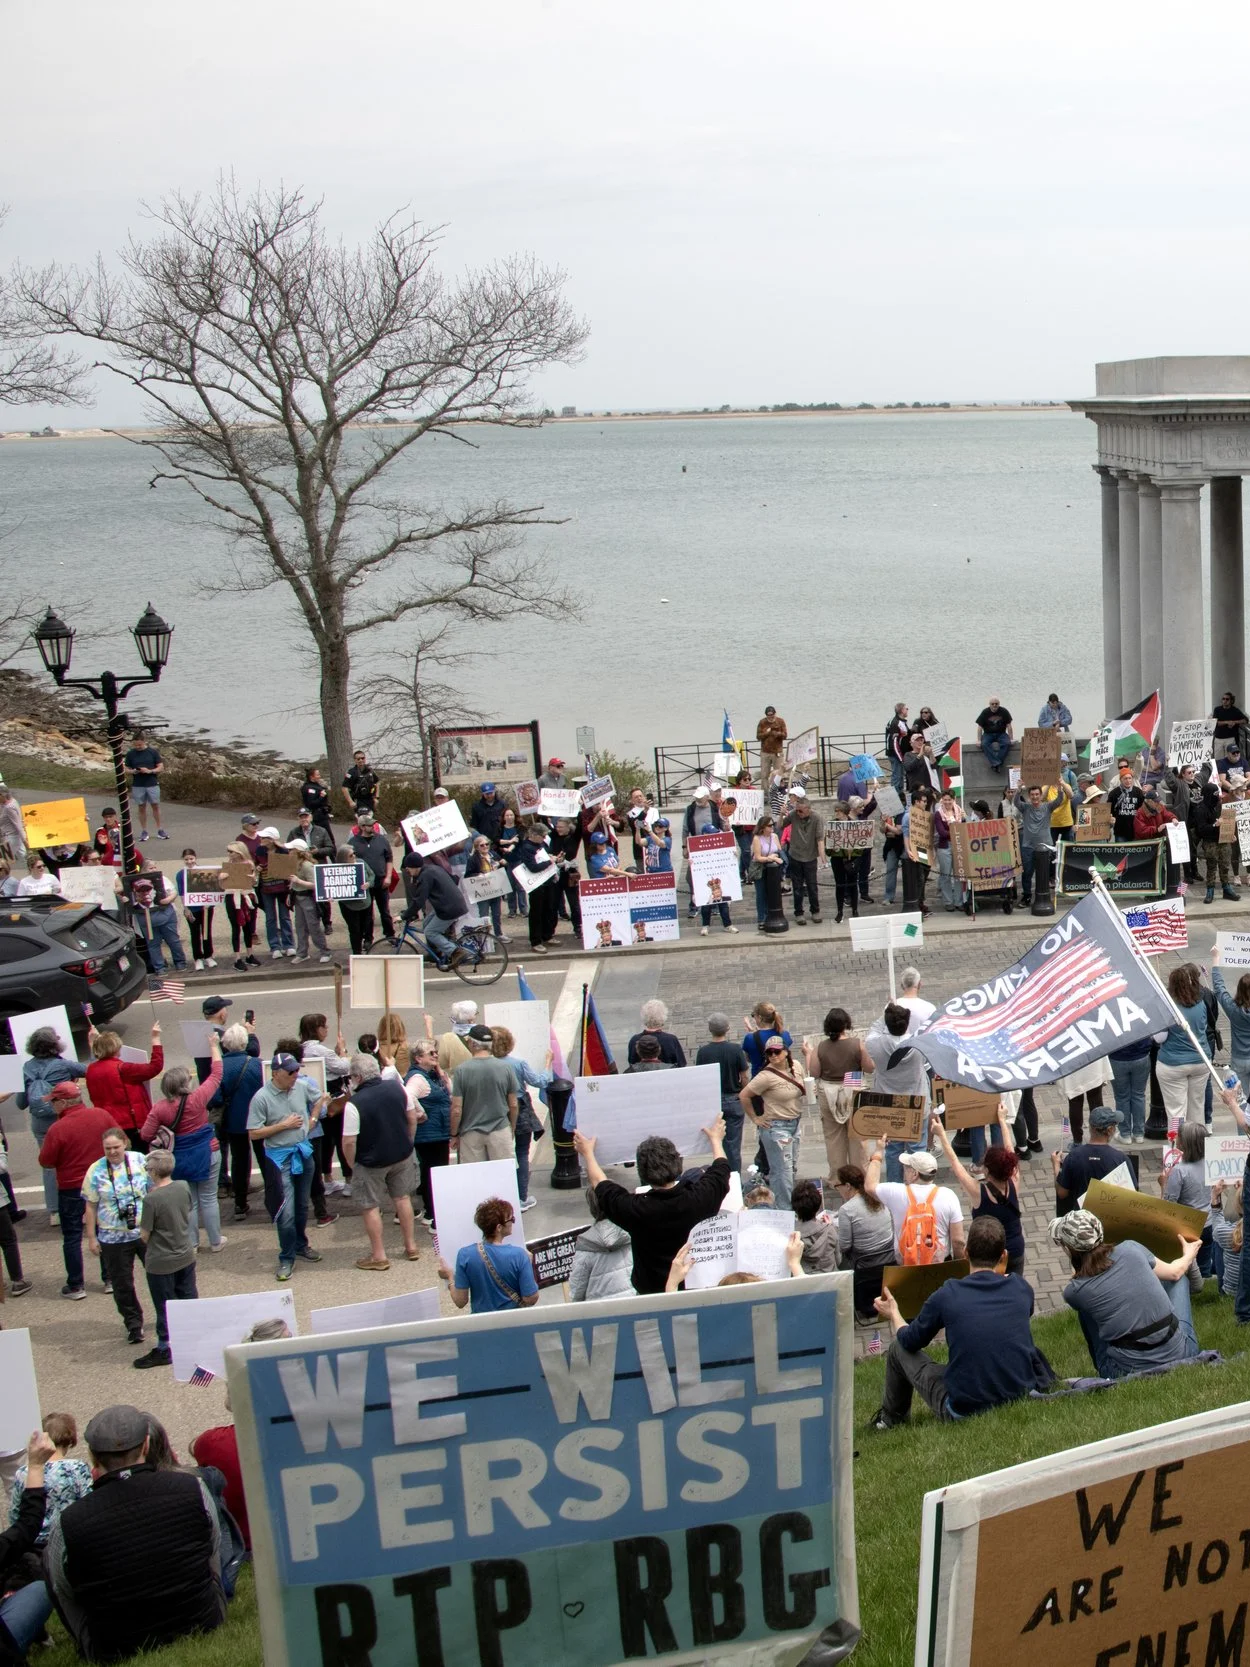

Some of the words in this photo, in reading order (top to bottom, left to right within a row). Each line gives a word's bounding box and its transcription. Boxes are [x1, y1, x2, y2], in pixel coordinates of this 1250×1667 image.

[1184, 724, 1202, 732] STOP
[1170, 739, 1204, 753] KIDNAPPING
[1177, 750, 1202, 764] NOW
[828, 822, 860, 831] TRUMP
[966, 820, 1008, 839] HANDS
[970, 836, 999, 852] OFF
[323, 866, 356, 876] VETERANS
[324, 875, 357, 886] AGAINST
[324, 885, 358, 898] TRUMP
[535, 1252, 546, 1264] ARE
[546, 1249, 558, 1262] WE
[557, 1243, 576, 1260] GREAT
[560, 1257, 573, 1267] JUS
[276, 1338, 467, 1454] WE
[533, 1303, 824, 1424] WILL
[280, 1397, 825, 1562] PERSIST
[1076, 1460, 1184, 1552] WE
[613, 1511, 831, 1660] RBG
[1020, 1565, 1124, 1635] ARE
